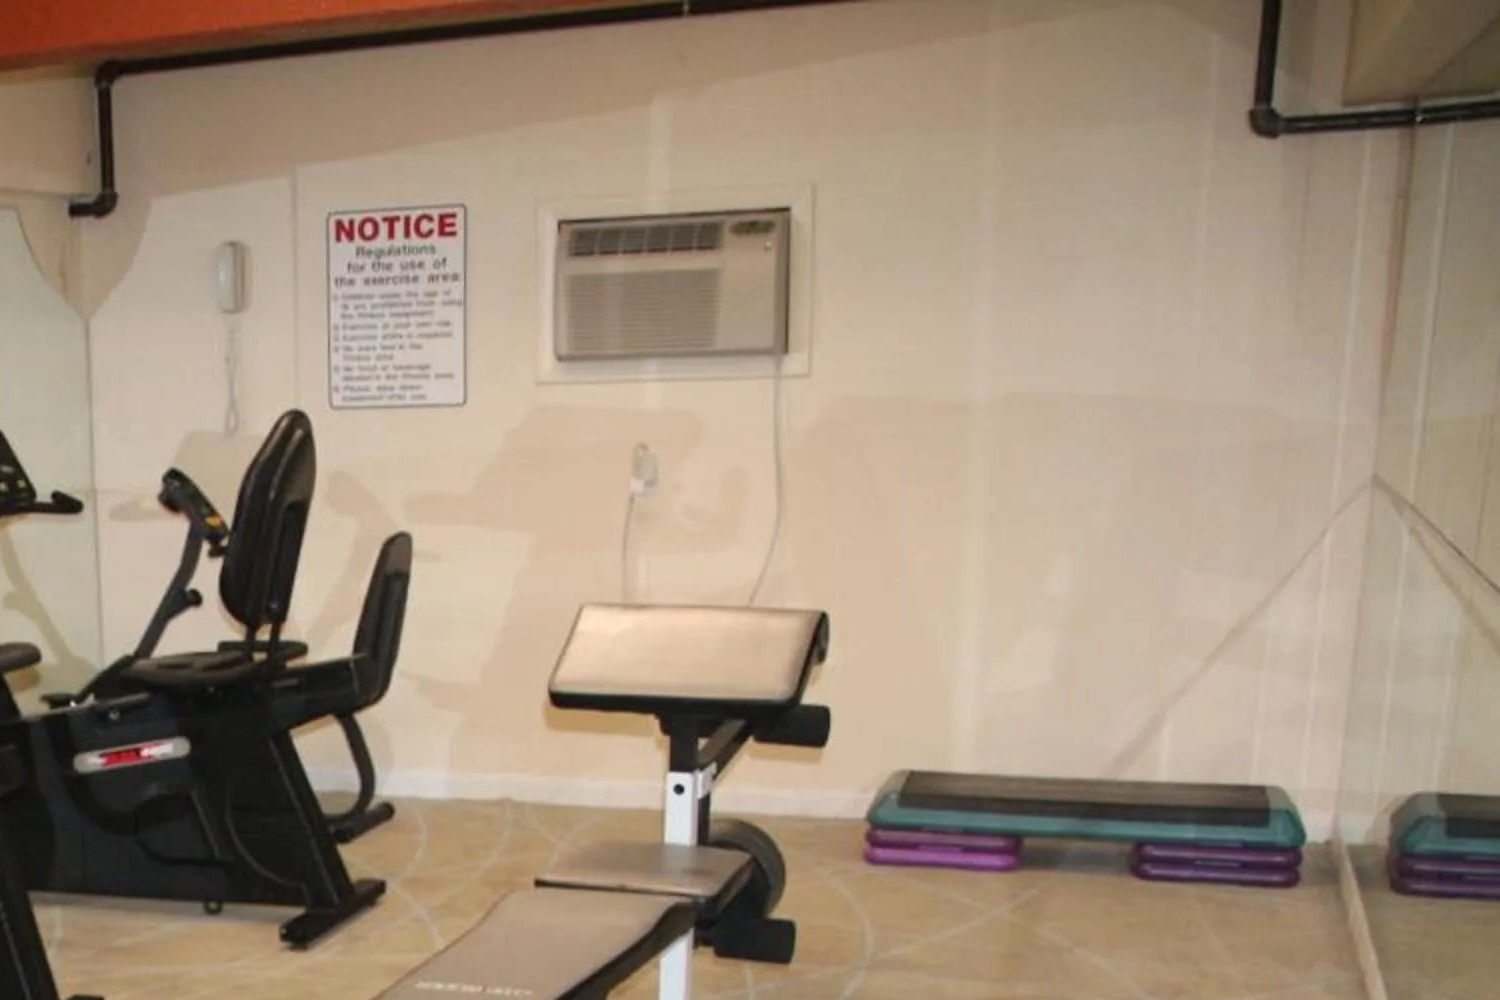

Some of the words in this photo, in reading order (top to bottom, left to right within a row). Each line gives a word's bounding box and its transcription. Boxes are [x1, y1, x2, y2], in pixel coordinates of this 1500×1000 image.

[335, 213, 457, 243] NOTICE
[372, 260, 393, 273] the
[400, 260, 425, 271] use
[433, 257, 447, 270] of
[334, 276, 356, 288] the
[363, 274, 420, 287] exercise
[427, 273, 460, 284] area
